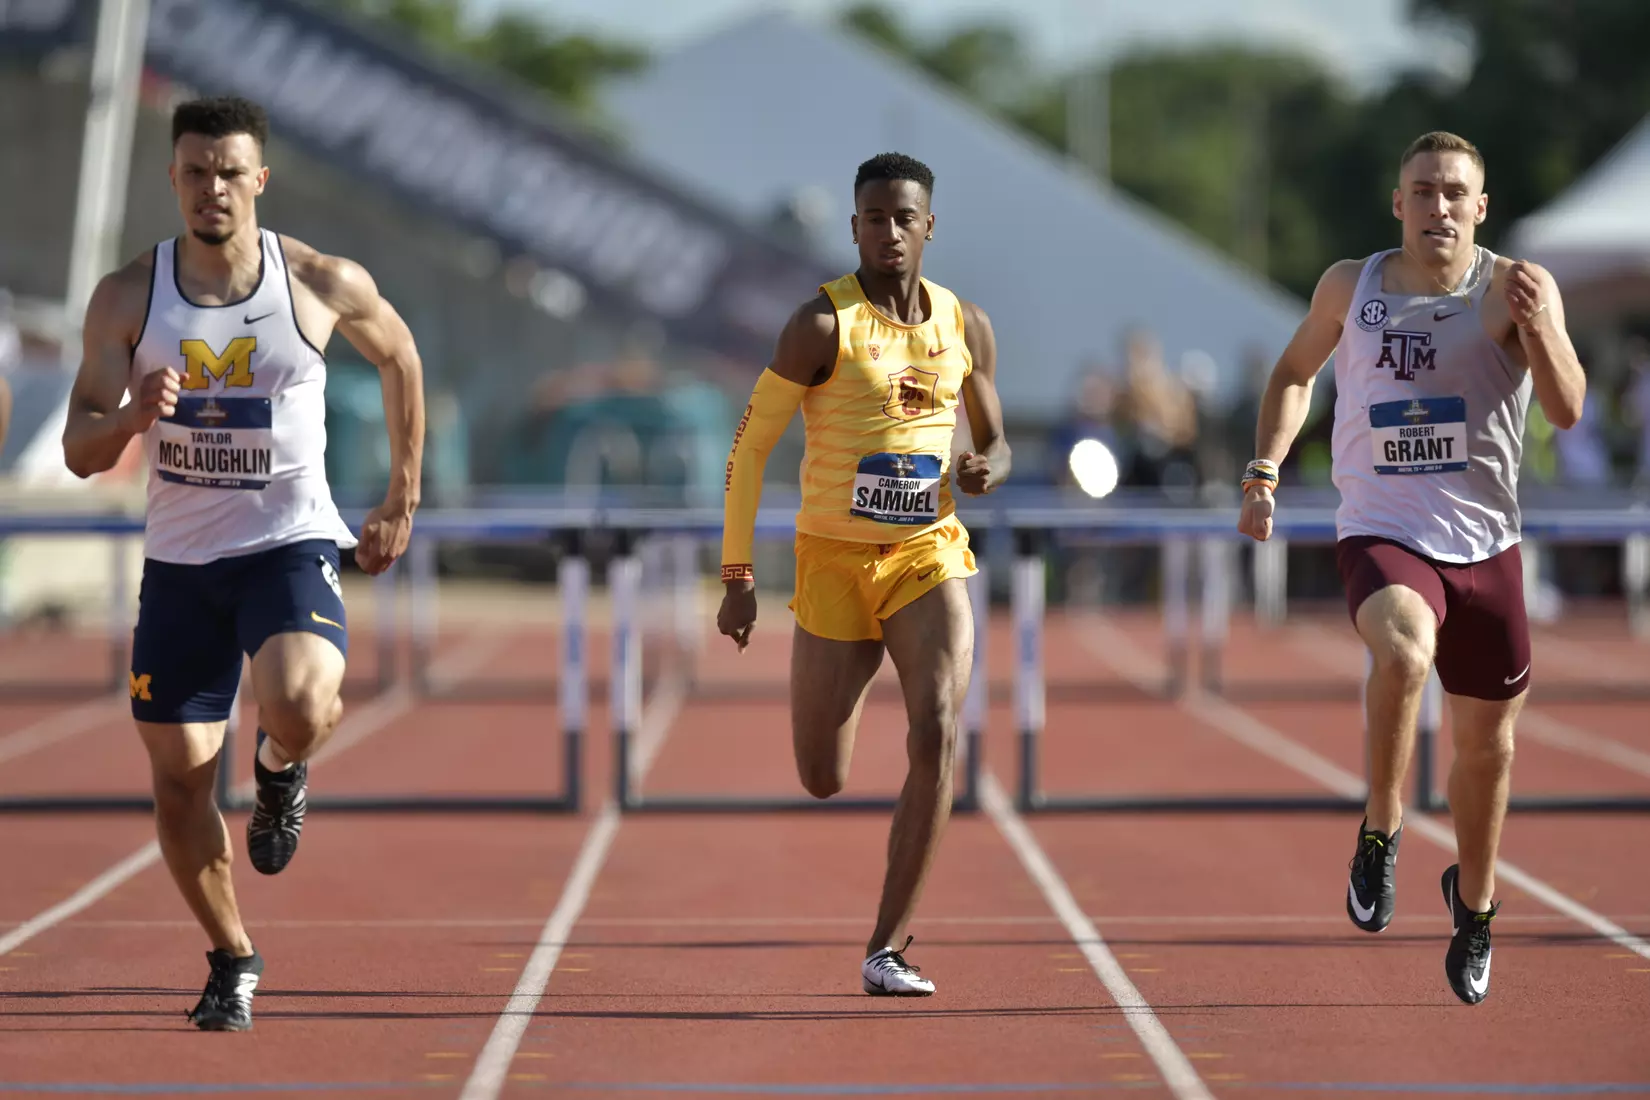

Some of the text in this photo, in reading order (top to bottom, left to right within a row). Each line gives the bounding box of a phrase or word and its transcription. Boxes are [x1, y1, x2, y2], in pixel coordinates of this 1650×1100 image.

[1363, 301, 1385, 324] SEC
[179, 336, 257, 392] M
[190, 431, 232, 445] TAYLOR
[1399, 426, 1435, 438] ROBERT
[159, 440, 271, 475] MCLAUGHLIN
[1383, 436, 1454, 462] GRANT
[878, 477, 921, 490] CAMERON
[856, 486, 935, 513] SAMUEL
[129, 672, 152, 701] M
